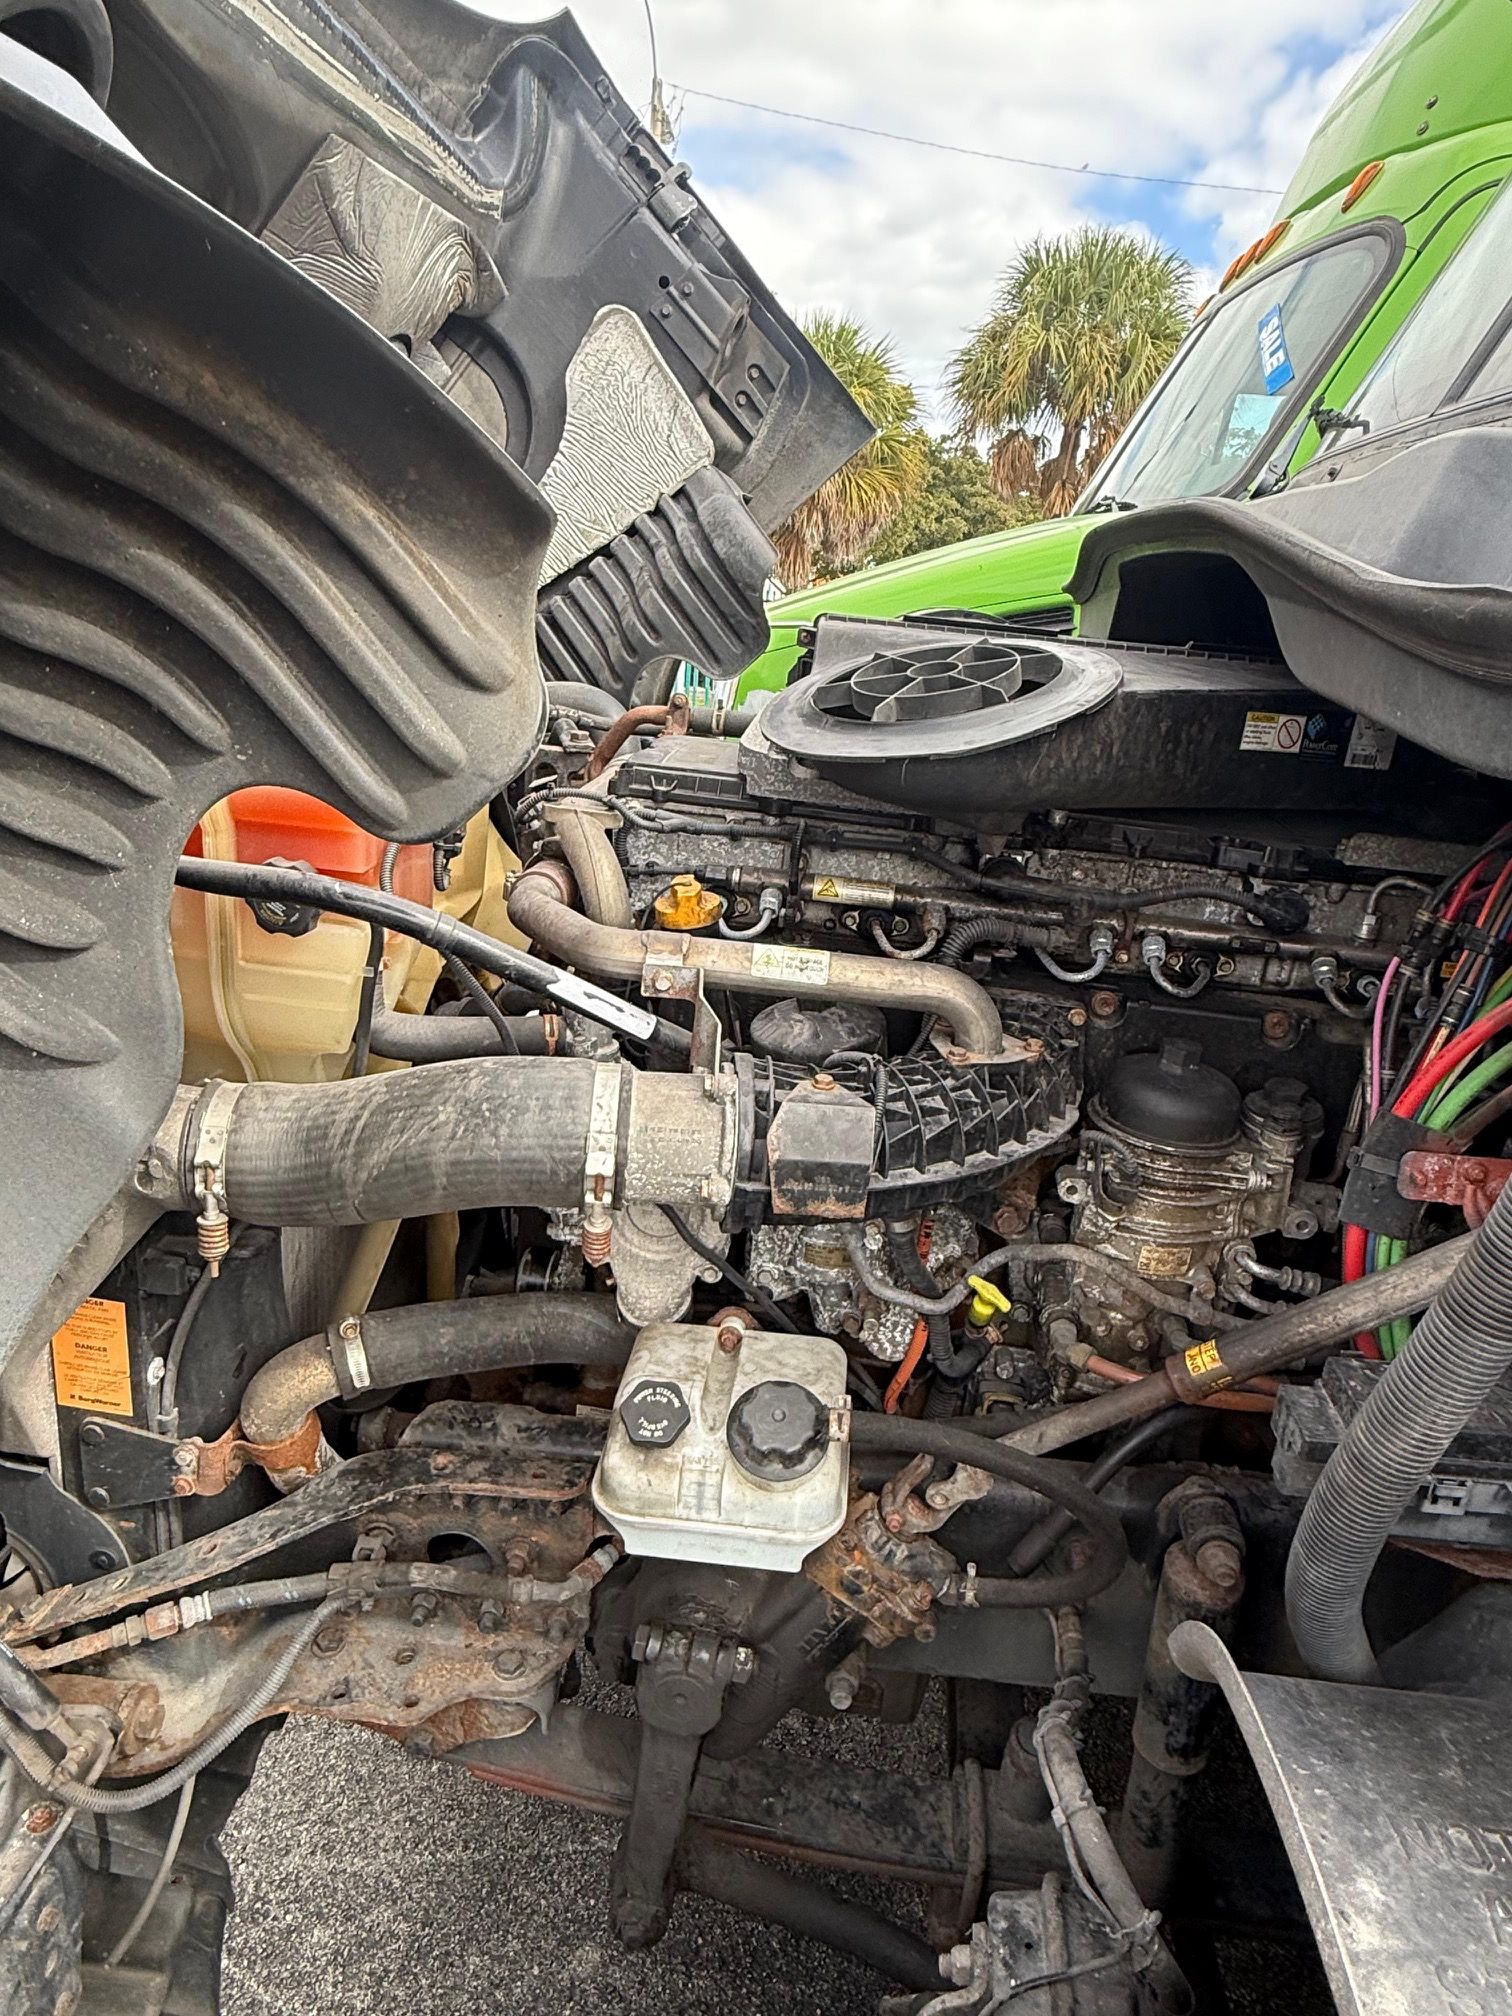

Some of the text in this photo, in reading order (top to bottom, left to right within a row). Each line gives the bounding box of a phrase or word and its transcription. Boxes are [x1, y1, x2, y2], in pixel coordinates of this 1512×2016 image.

[1259, 316, 1285, 377] SALE
[74, 1342, 108, 1353] DANGER
[646, 1394, 668, 1403] FLUID
